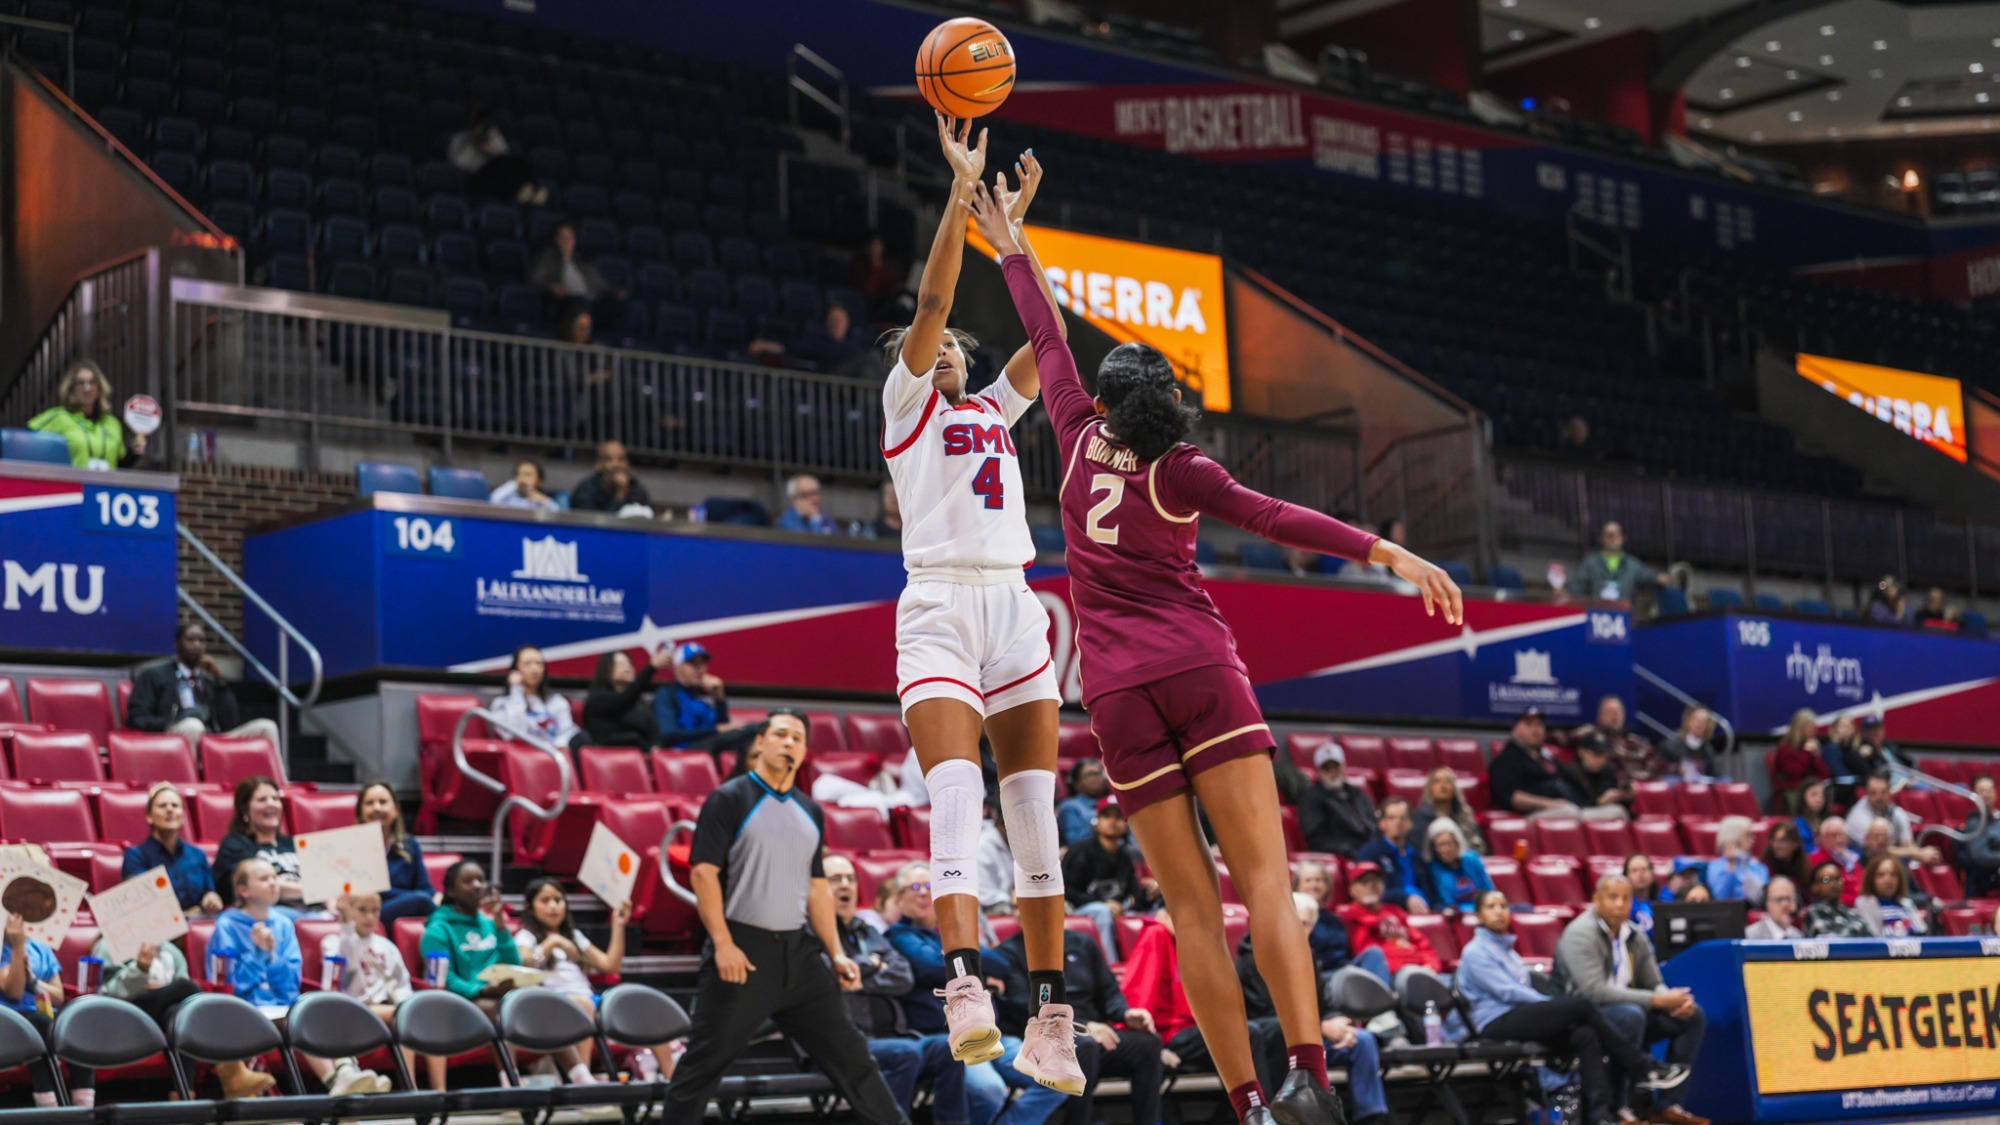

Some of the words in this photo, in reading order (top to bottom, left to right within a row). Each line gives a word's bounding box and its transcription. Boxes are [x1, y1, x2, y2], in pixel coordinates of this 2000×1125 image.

[1164, 94, 1306, 153] BASKETBALL
[1045, 266, 1206, 334] SIERRA
[971, 456, 1004, 510] 4
[1086, 473, 1126, 545] 2
[96, 492, 160, 529] 103
[393, 516, 456, 553] 104
[1590, 612, 1627, 640] 104
